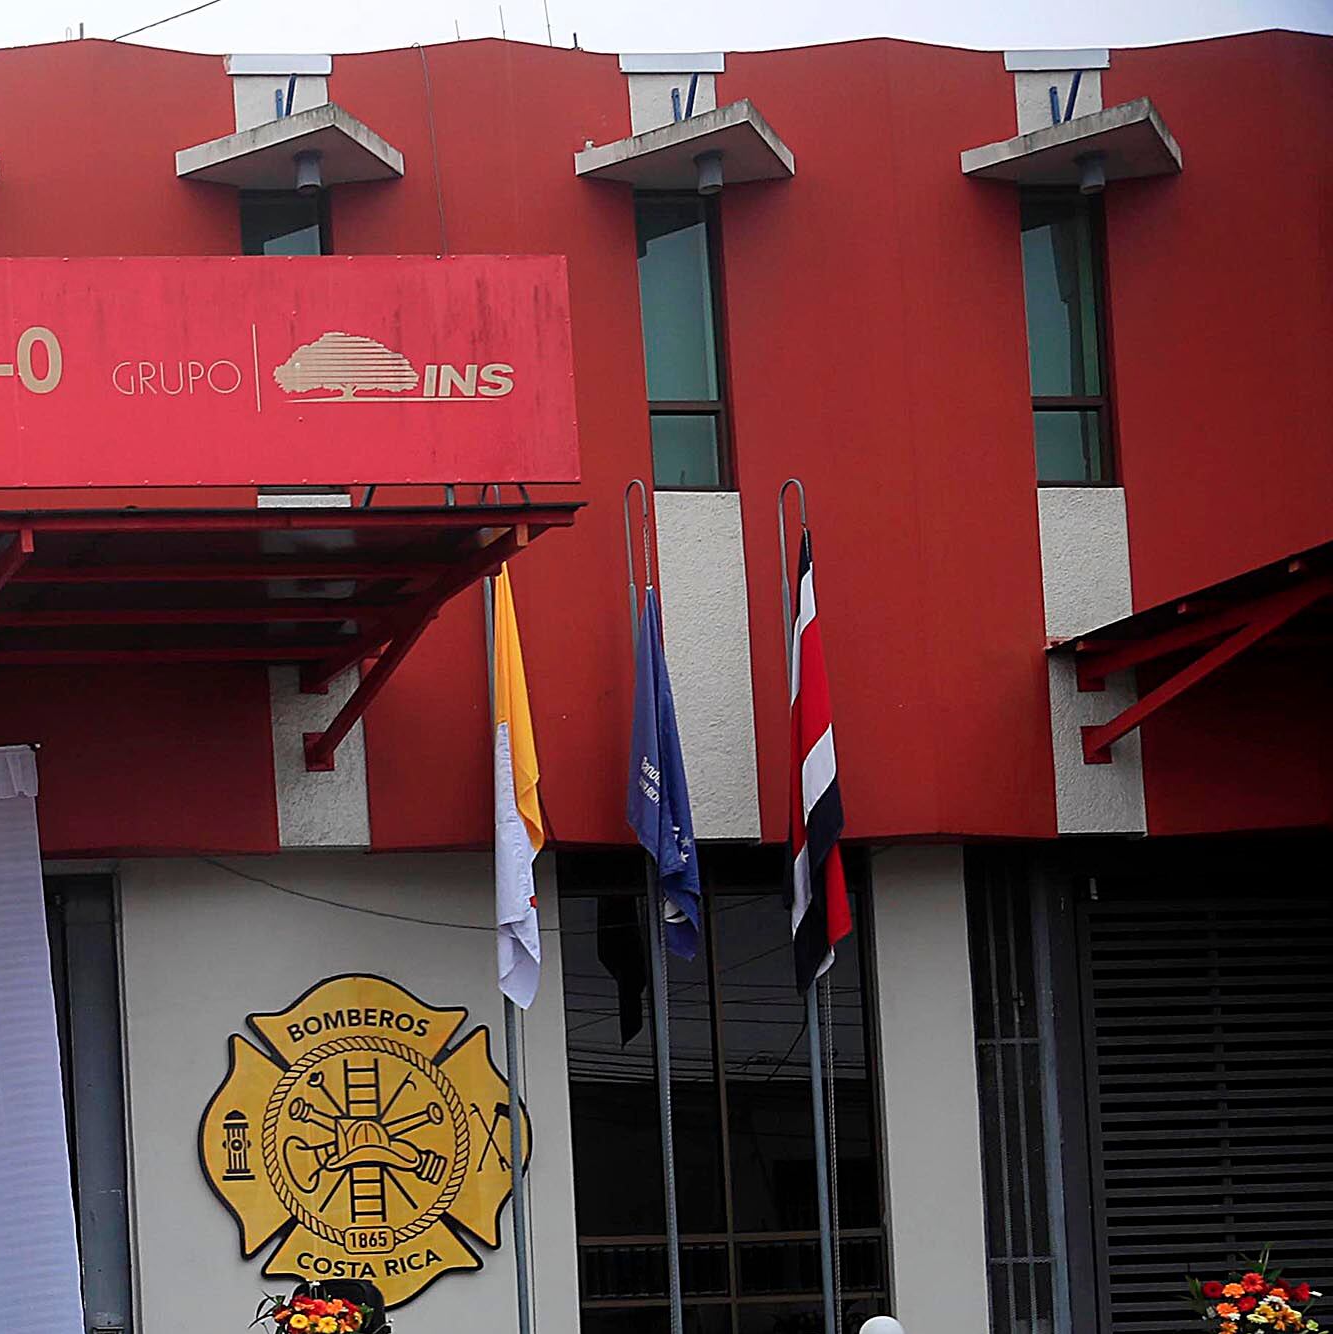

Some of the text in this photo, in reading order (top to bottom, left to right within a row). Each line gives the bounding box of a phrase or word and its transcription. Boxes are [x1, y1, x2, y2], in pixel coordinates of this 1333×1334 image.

[111, 359, 241, 397] GRUPO
[421, 362, 515, 398] INS
[286, 1007, 431, 1043] BOMBEROS
[349, 1231, 389, 1249] 1865
[296, 1249, 443, 1279] COSTA RICA
